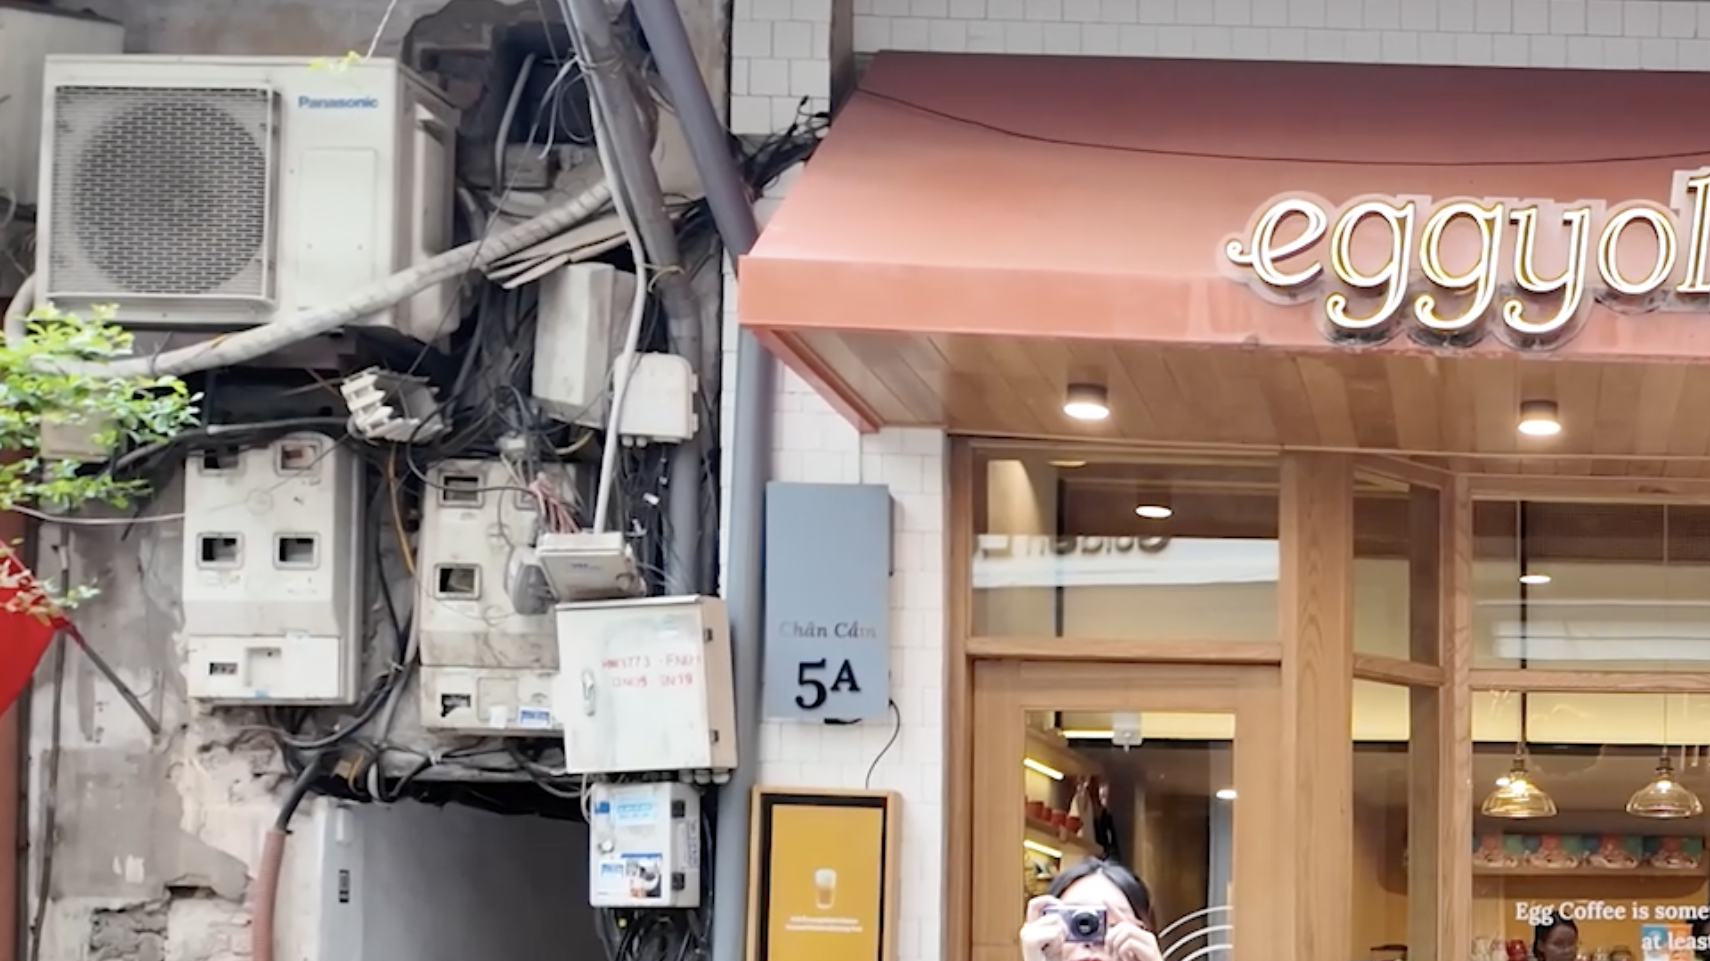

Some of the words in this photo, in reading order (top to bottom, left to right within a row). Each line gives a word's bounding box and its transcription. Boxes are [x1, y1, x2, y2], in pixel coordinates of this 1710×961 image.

[298, 95, 378, 109] Panasonic
[795, 657, 861, 710] 5A
[1515, 901, 1554, 926] Egg
[1558, 900, 1627, 920] Coffee
[1632, 901, 1650, 920] is
[1641, 933, 1661, 950] at
